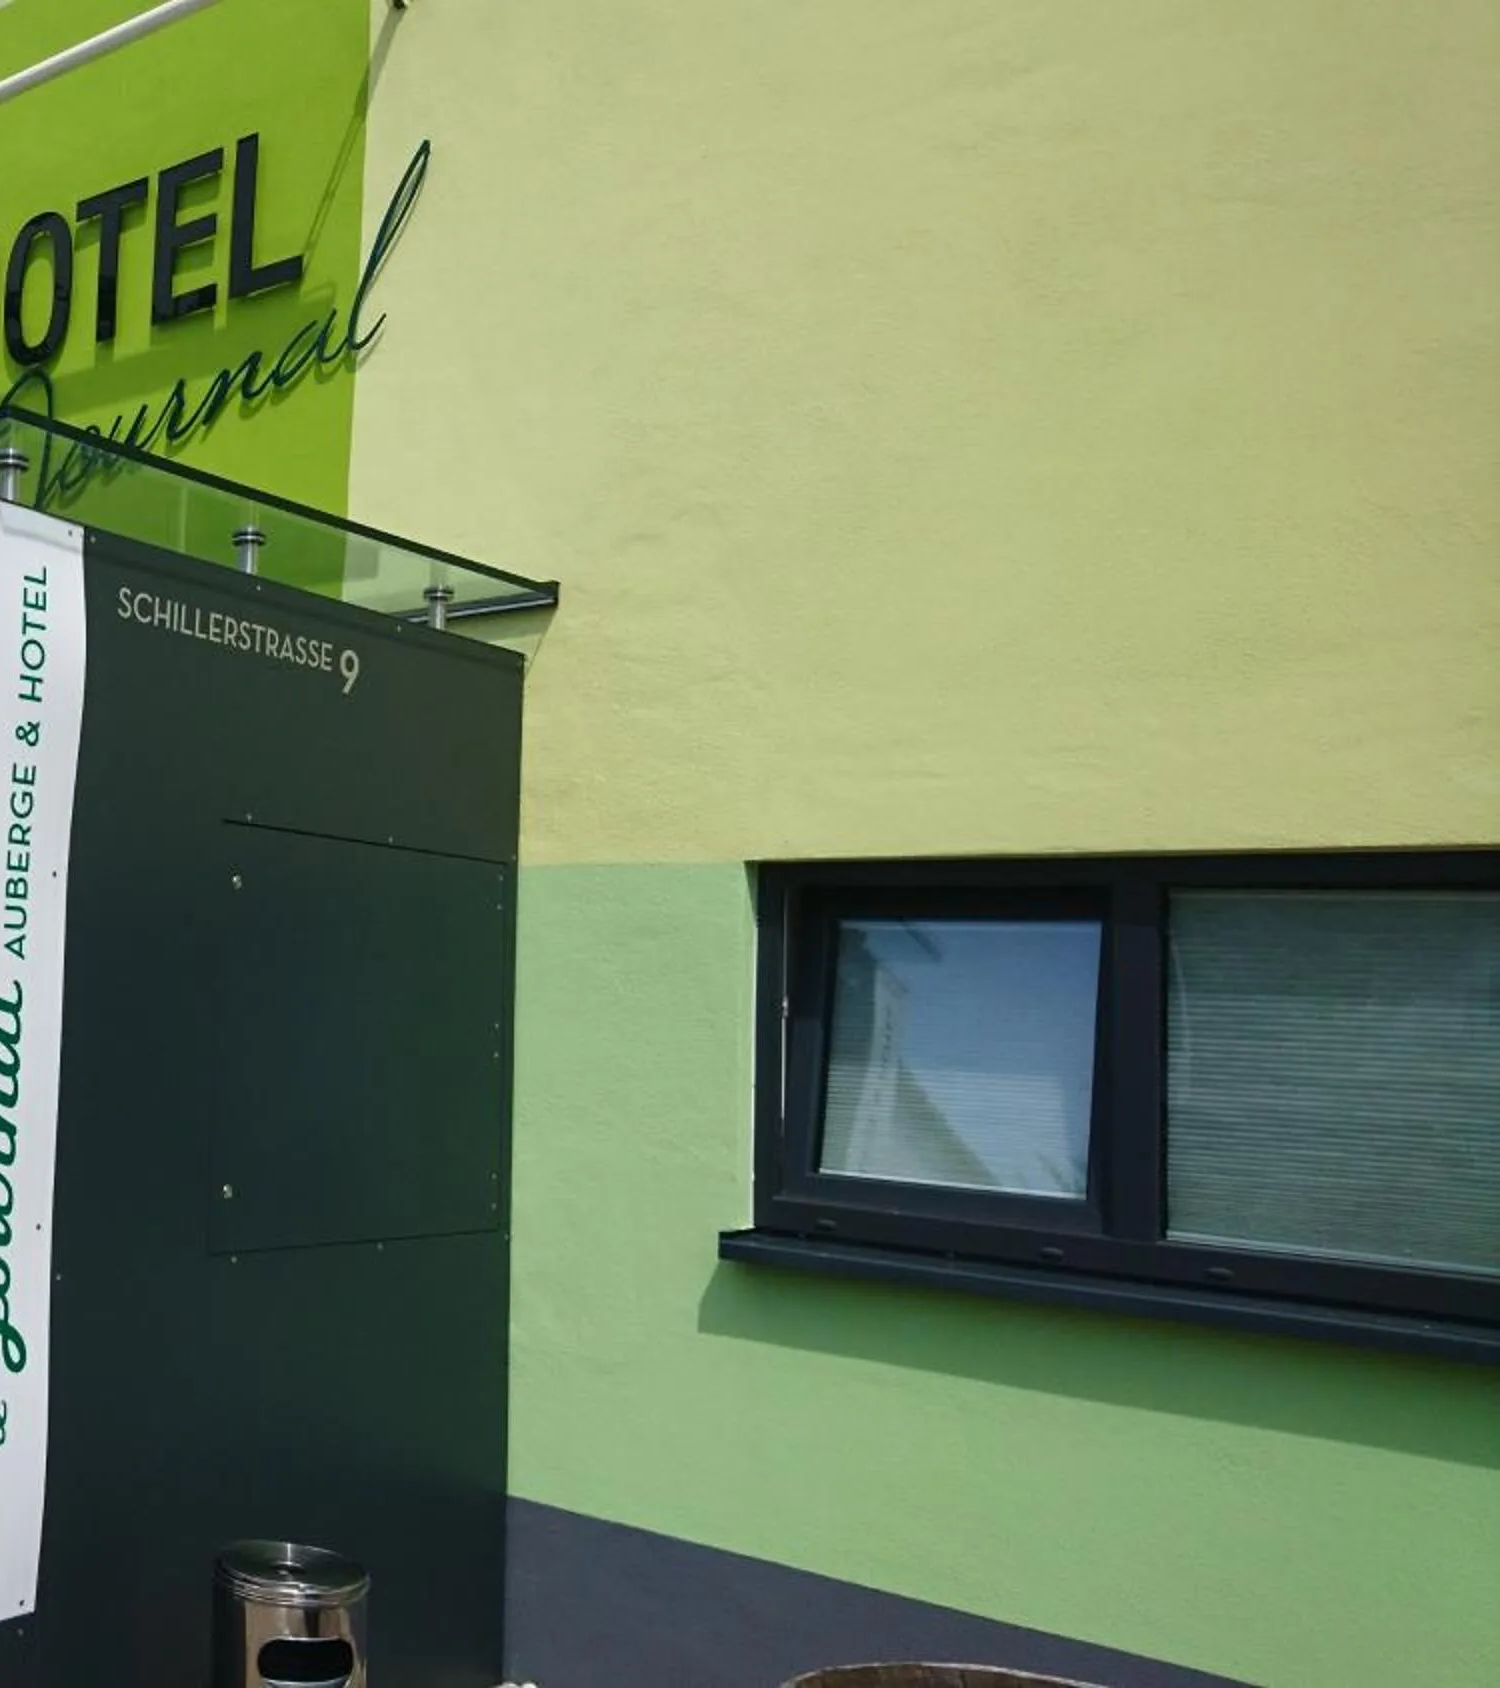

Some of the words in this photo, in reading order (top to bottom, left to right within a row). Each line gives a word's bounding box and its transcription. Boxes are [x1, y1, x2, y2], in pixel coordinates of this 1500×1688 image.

[18, 566, 48, 702] HOTEL
[117, 587, 333, 671] SCHILLERSTRASSE
[339, 649, 360, 694] 9
[16, 721, 40, 747] &
[4, 763, 37, 960] AUBERGE
